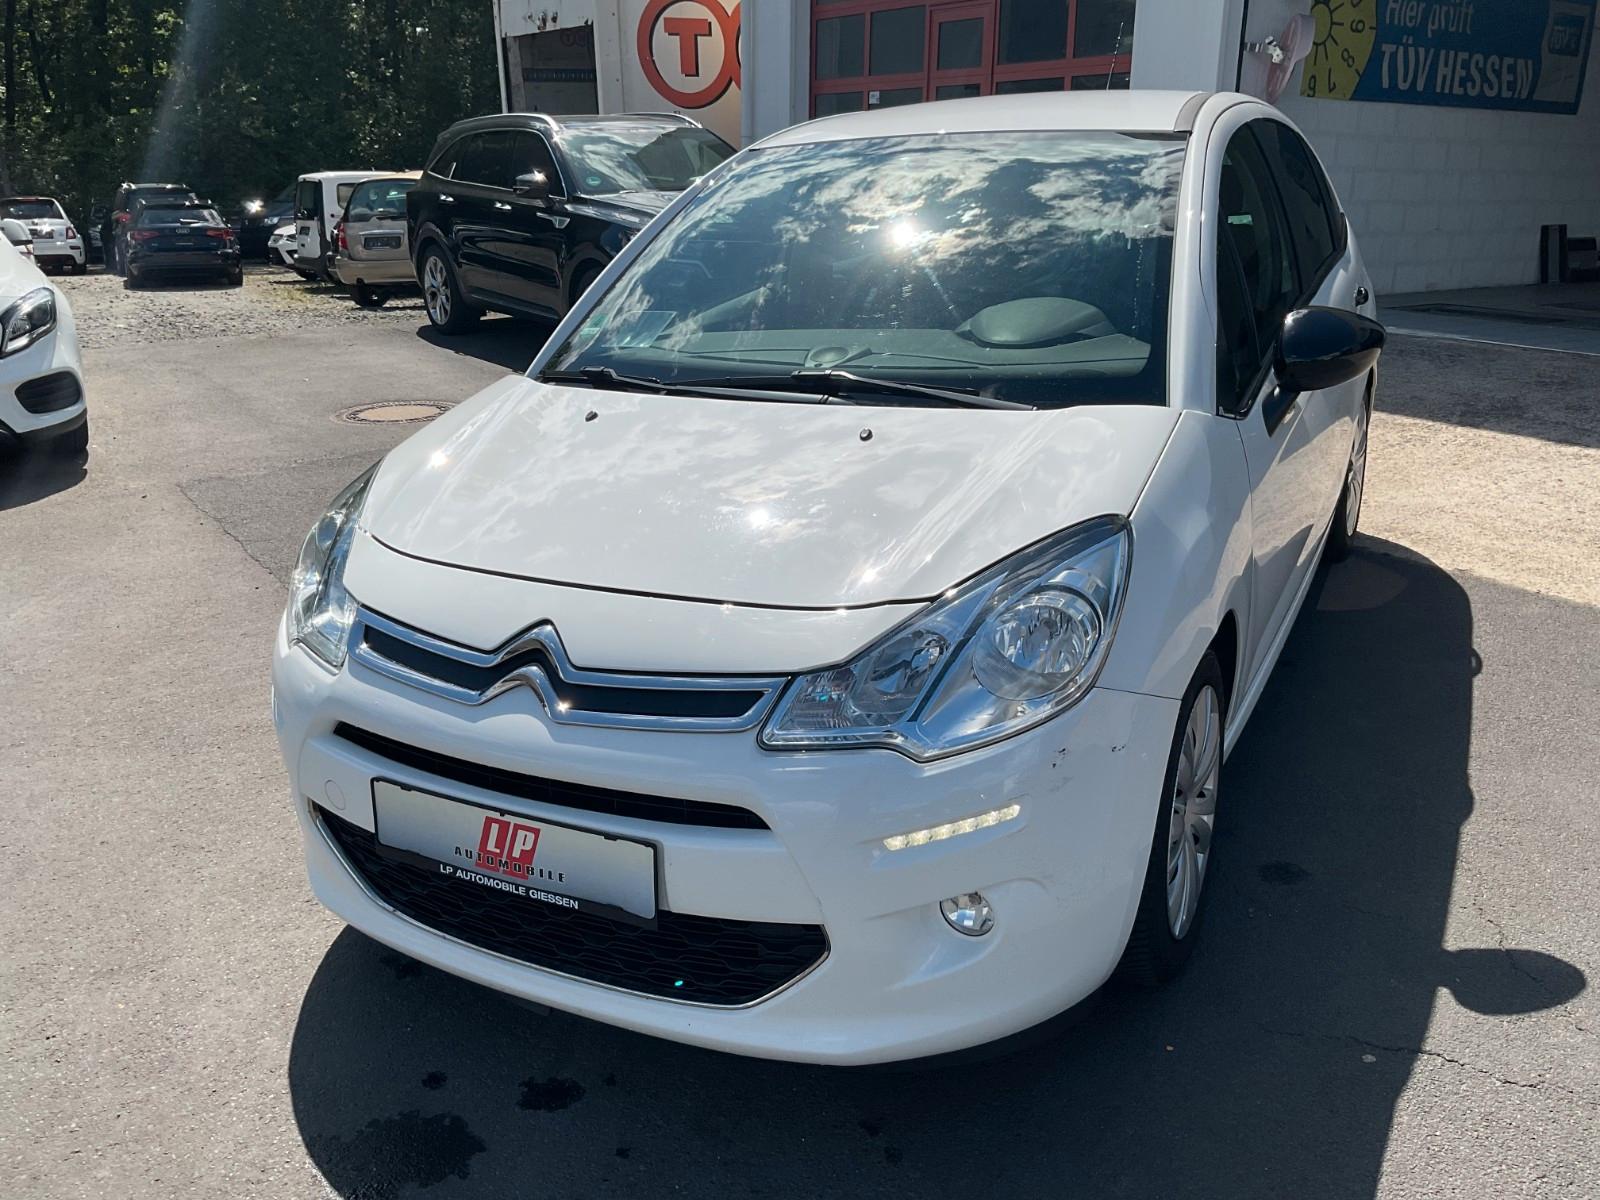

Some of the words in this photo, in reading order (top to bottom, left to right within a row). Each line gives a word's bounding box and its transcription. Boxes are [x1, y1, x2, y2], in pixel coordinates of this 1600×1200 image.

[1385, 0, 1426, 27] Hier
[664, 17, 712, 77] T
[1381, 36, 1435, 91] TÜV
[1436, 49, 1533, 99] HESSEN
[487, 823, 535, 858] LP
[454, 846, 566, 882] AUTOMOBILE
[440, 864, 453, 874] LP
[456, 870, 526, 896] AUTOMOBILE
[529, 889, 579, 909] GIESSEN
